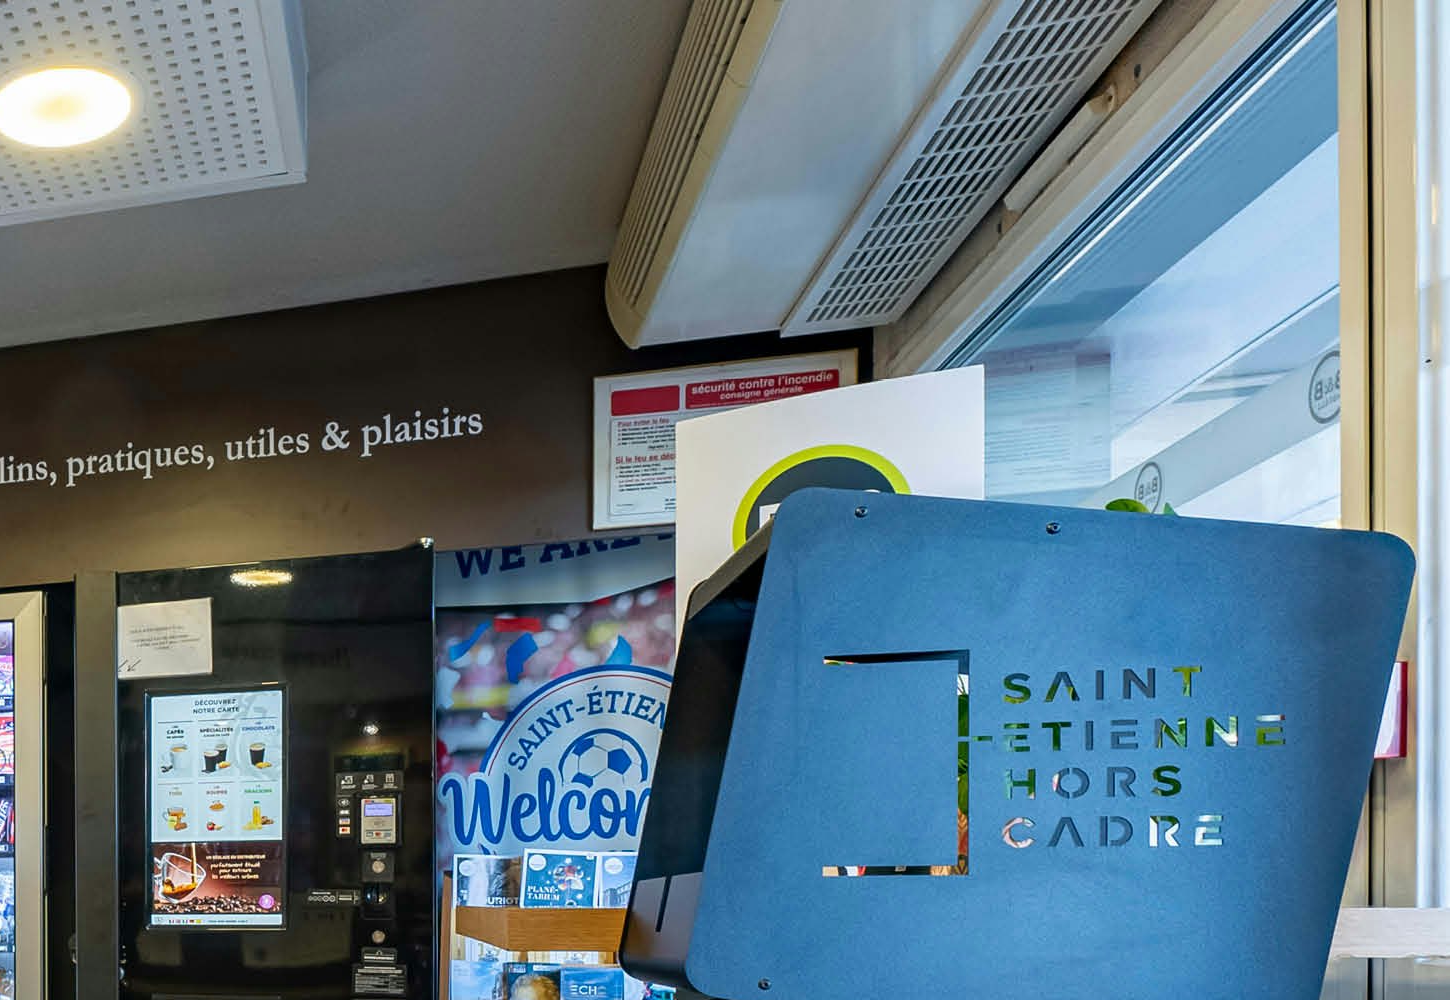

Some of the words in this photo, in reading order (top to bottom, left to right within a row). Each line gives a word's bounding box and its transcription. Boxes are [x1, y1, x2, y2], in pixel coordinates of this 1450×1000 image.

[691, 379, 736, 395] sécurité
[738, 378, 775, 391] contre
[777, 372, 834, 387] l'incendie
[719, 389, 761, 402] consigne
[65, 441, 215, 488] pratiques,
[224, 428, 310, 461] utiles
[320, 422, 350, 451] &
[359, 407, 484, 457] plaisirs
[455, 545, 527, 578] WE
[1001, 665, 1203, 705] SAINT
[192, 706, 216, 714] NOTRE
[508, 686, 667, 771] SAINT-ÉTIEN
[1004, 764, 1184, 800] HORS
[442, 767, 651, 845] Welco
[1000, 814, 1226, 850] CADRE
[526, 892, 561, 901] TARIUM
